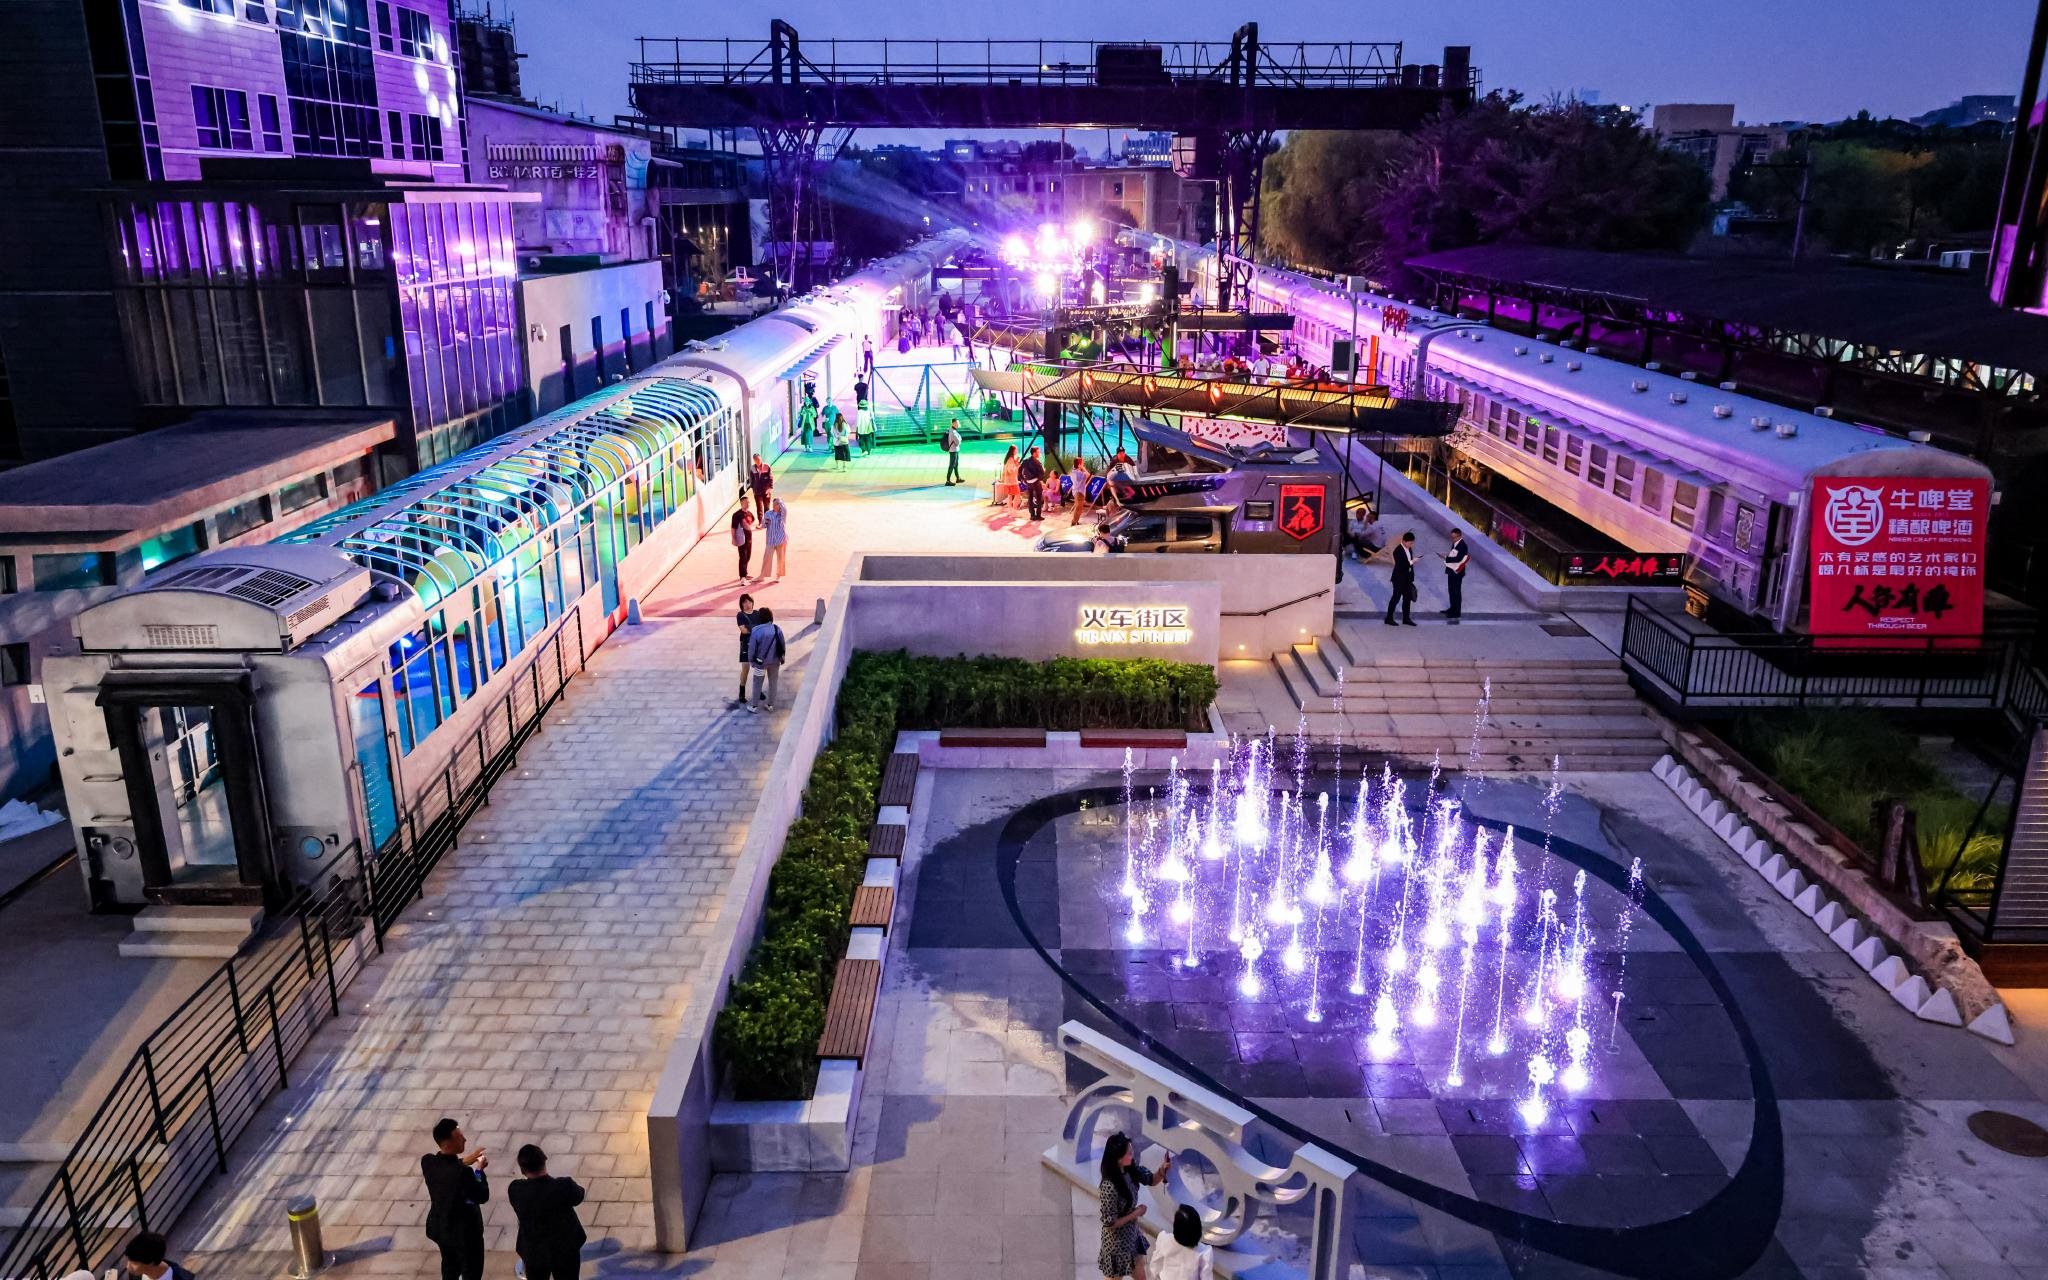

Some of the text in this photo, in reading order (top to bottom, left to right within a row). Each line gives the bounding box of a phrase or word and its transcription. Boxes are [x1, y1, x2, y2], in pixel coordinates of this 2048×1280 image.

[1890, 489, 1974, 511] 牛啤堂
[1888, 519, 1973, 535] 精酿啤酒
[1083, 608, 1186, 628] 火车街区
